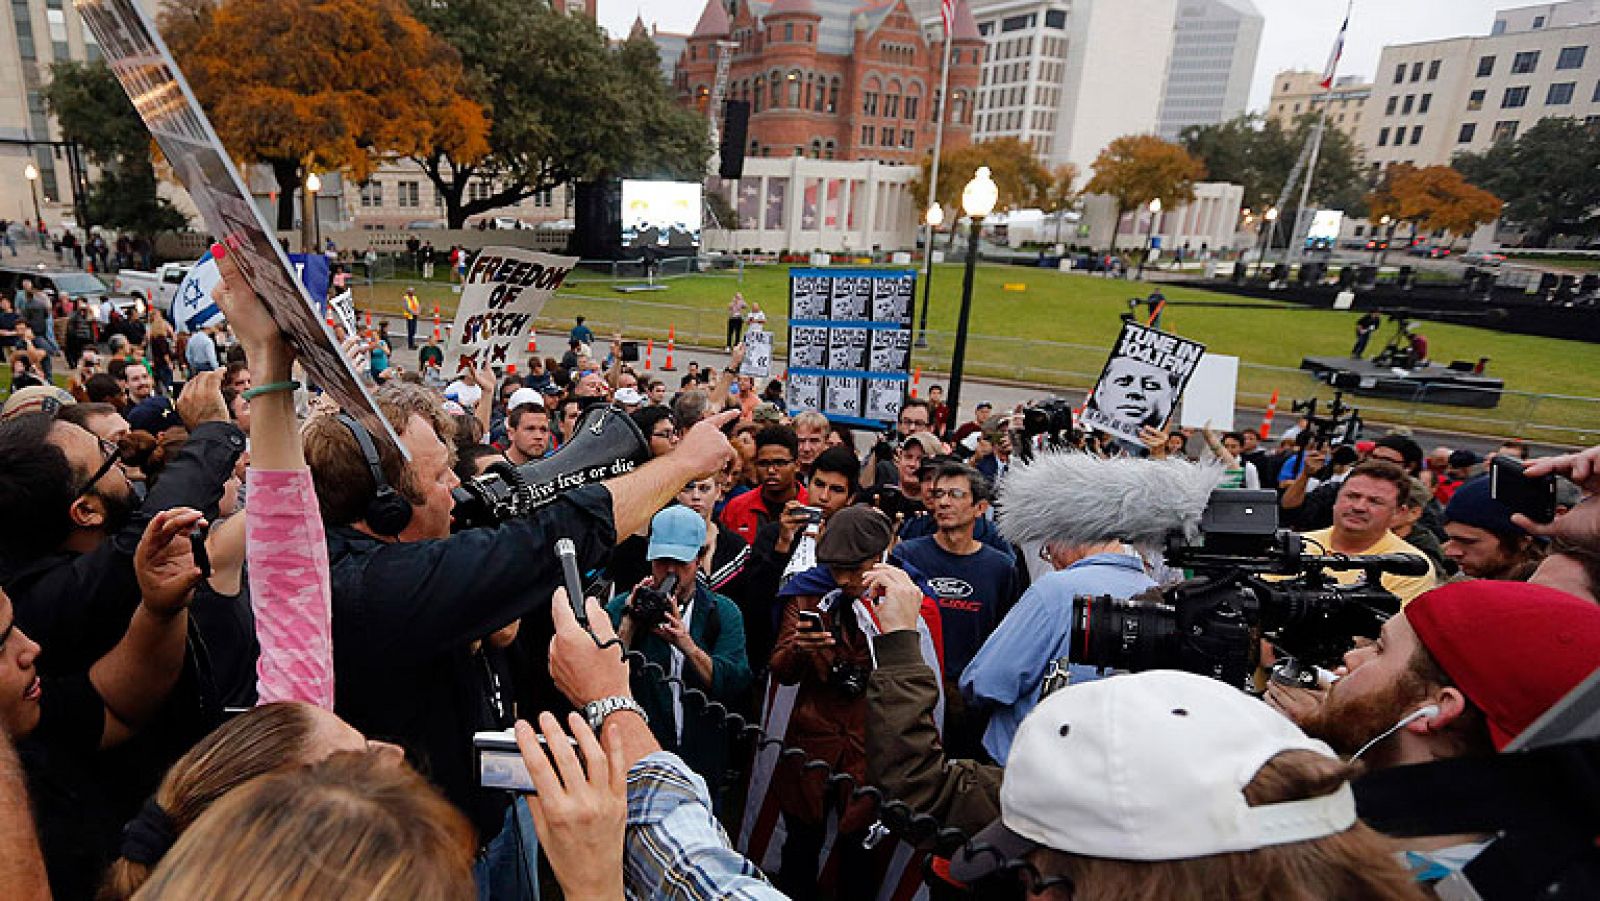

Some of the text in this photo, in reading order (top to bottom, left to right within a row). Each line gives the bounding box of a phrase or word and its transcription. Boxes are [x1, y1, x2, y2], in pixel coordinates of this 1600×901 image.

[468, 256, 571, 290] FREEDOM
[488, 284, 523, 309] OF
[1124, 325, 1204, 363] TUNE IN
[526, 458, 635, 501] live free or die
